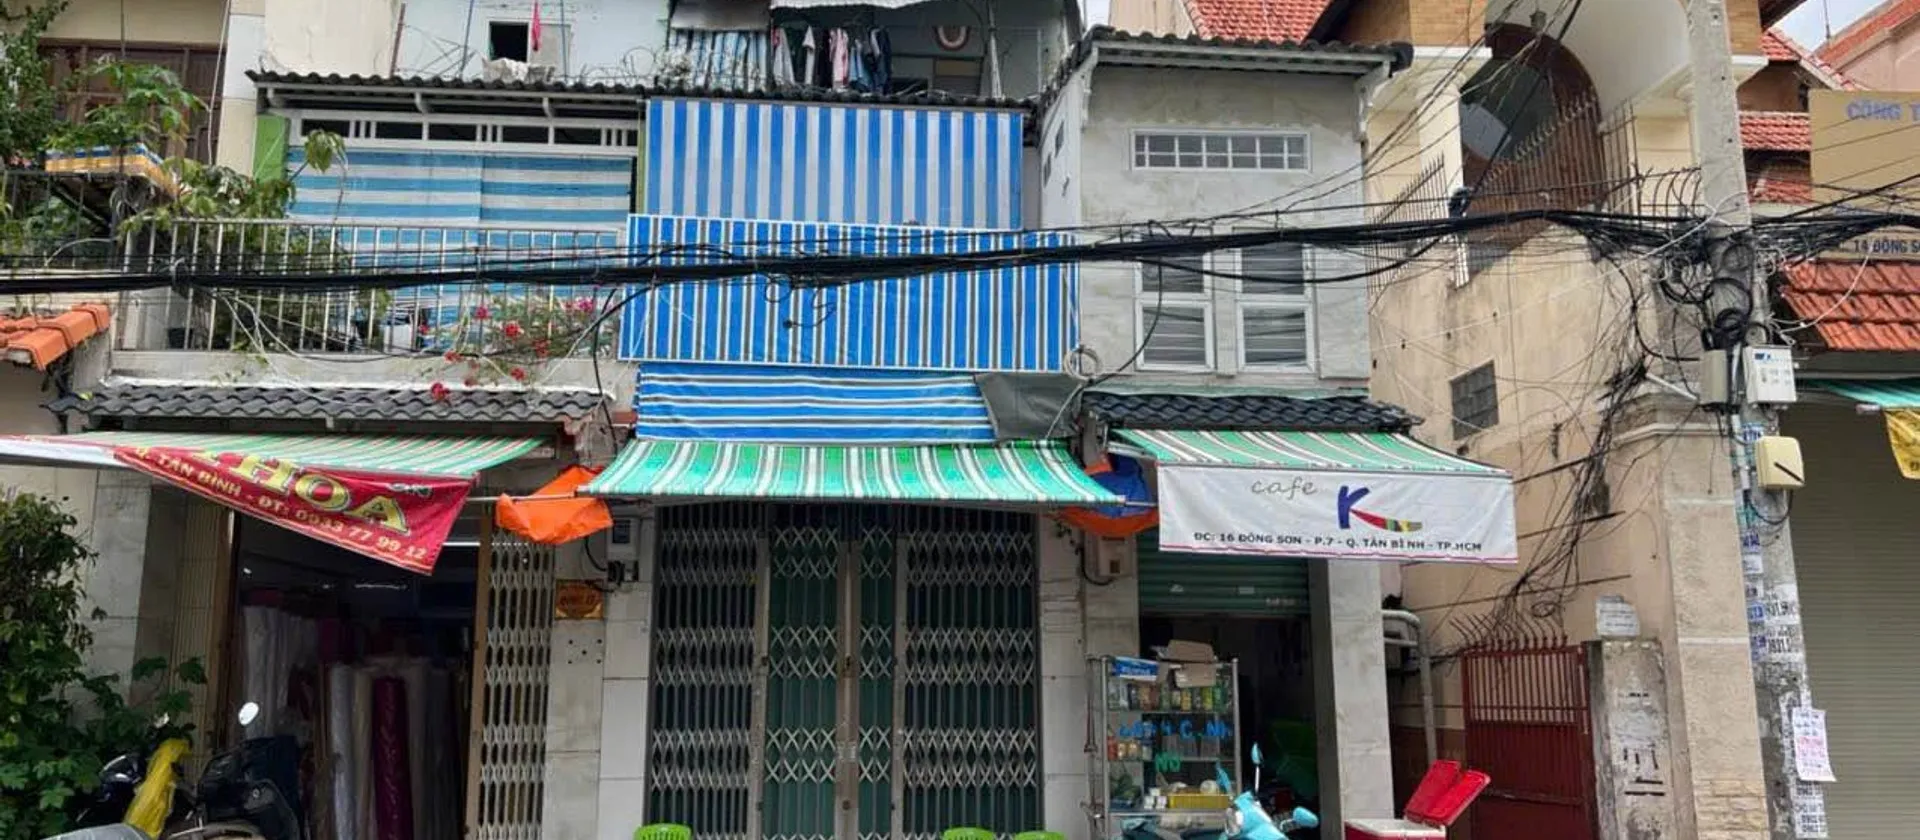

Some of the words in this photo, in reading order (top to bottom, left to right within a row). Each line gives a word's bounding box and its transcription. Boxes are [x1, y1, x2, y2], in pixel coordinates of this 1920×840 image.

[1251, 476, 1318, 500] cafe
[348, 525, 373, 541] 77
[376, 535, 401, 551] 99
[405, 545, 428, 559] 12
[1219, 533, 1236, 543] 16
